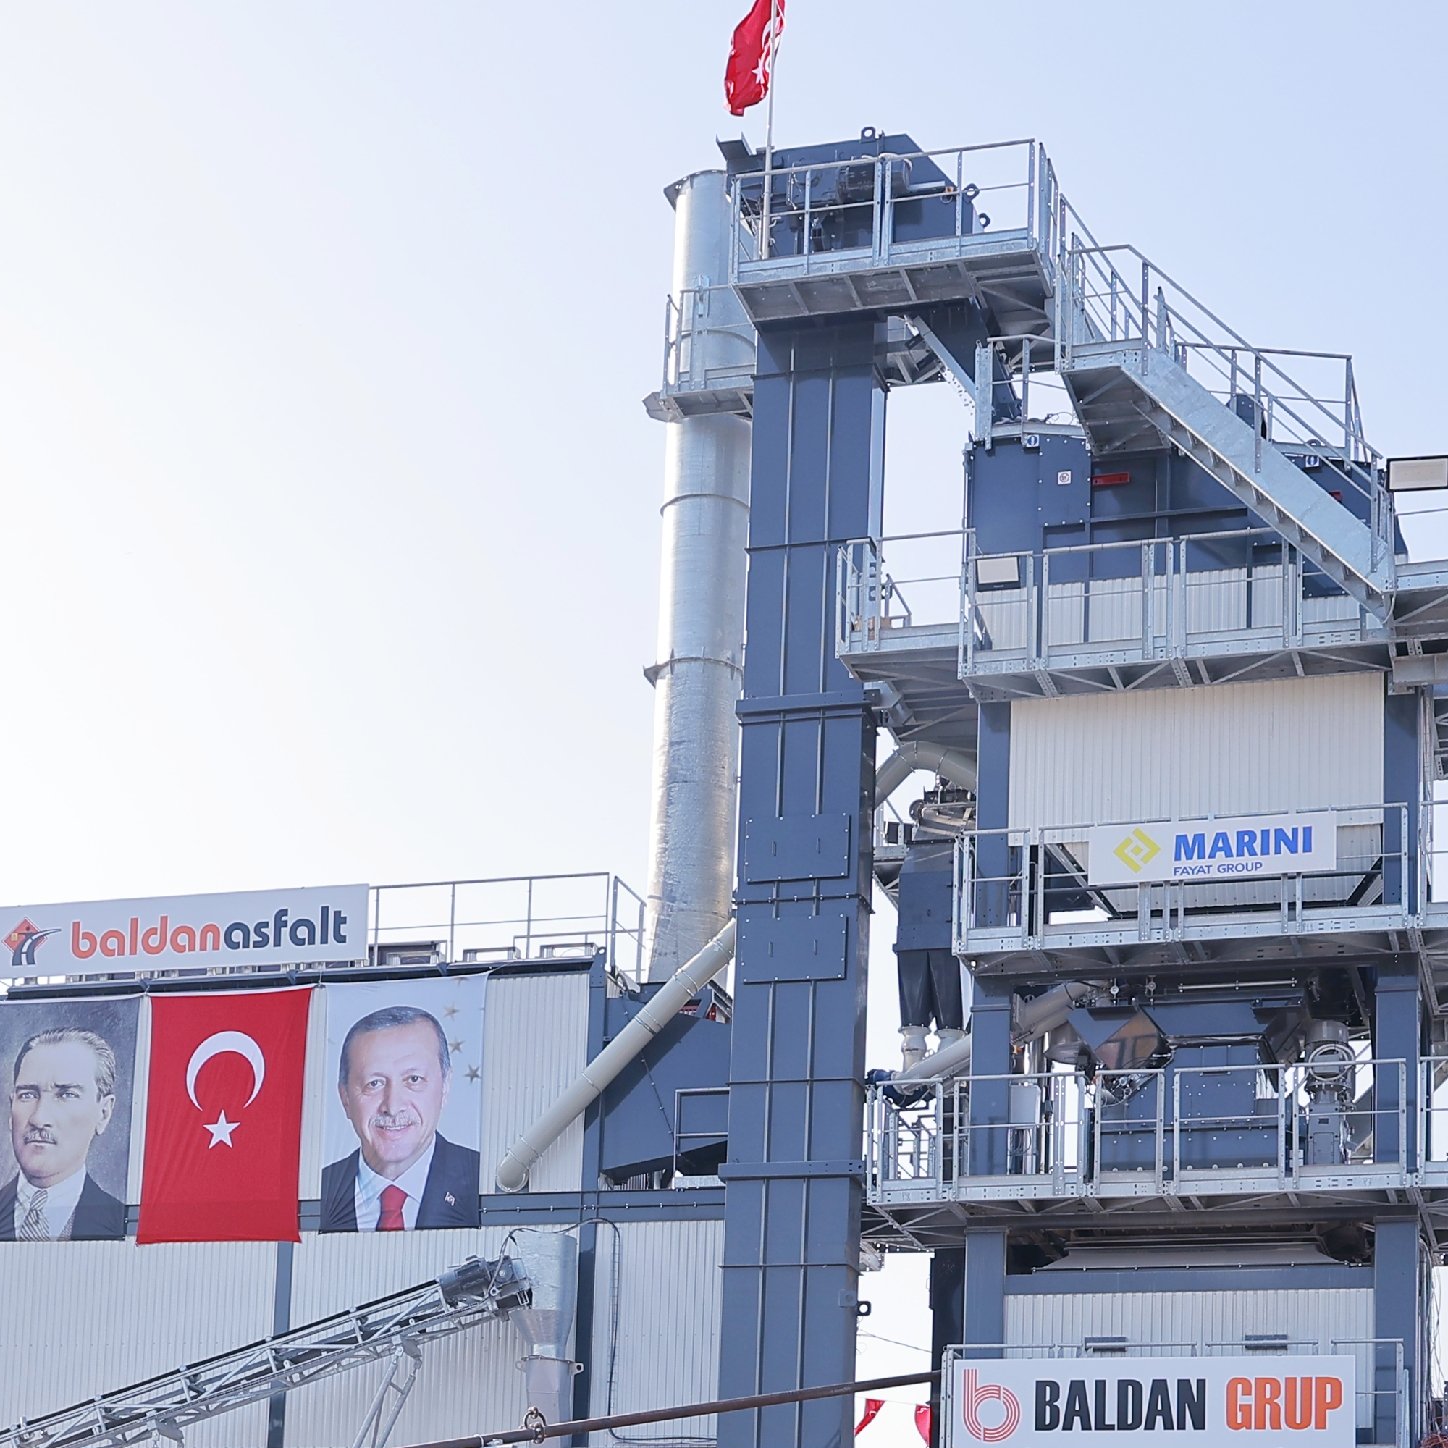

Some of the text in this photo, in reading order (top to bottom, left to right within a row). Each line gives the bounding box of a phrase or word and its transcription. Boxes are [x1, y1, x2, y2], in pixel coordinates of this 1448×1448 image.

[1174, 826, 1312, 861] MARINI
[1173, 861, 1263, 876] FAYAT GROUP
[71, 905, 348, 960] baldanasfalt
[1034, 1376, 1343, 1431] BALDAN GRUP
